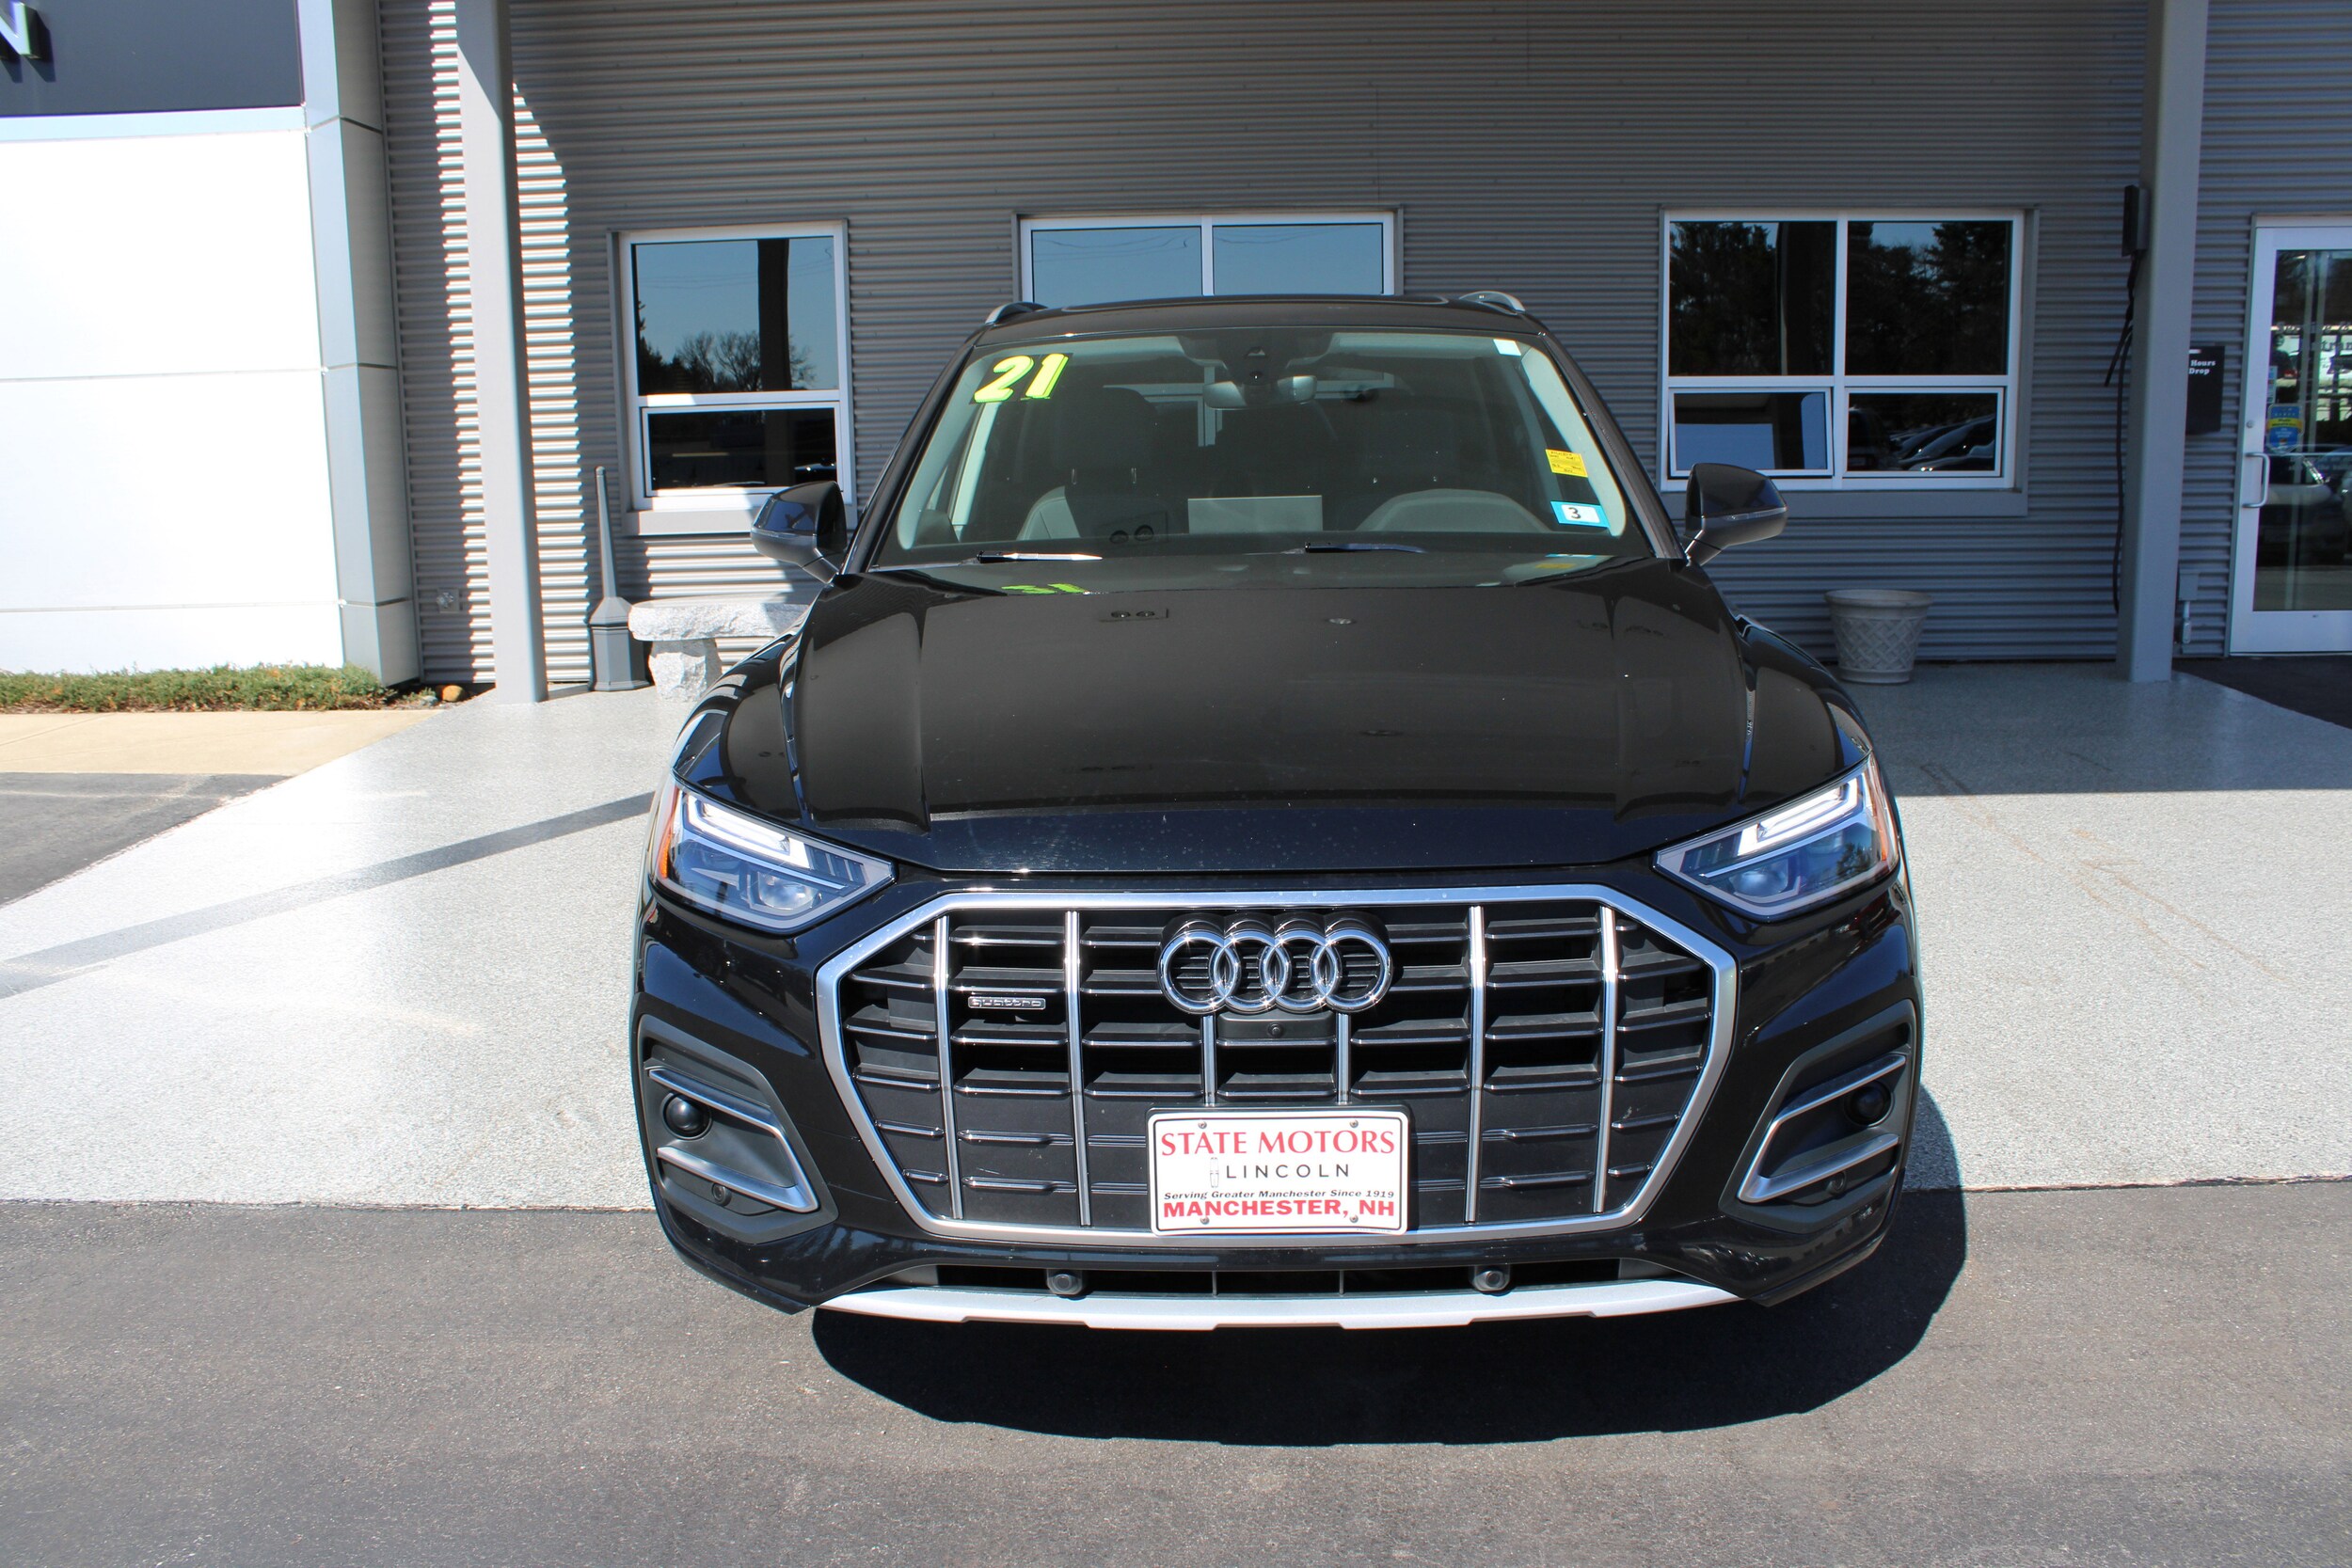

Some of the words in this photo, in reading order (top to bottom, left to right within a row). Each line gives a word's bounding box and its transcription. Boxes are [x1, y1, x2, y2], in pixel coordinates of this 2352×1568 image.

[974, 354, 1069, 404] 21
[1567, 506, 1581, 519] 3
[972, 998, 1042, 1007] quattro
[1161, 1132, 1247, 1156] STATE
[1258, 1131, 1395, 1154] MOTORS
[1226, 1164, 1349, 1179] LINCOLN
[1164, 1191, 1207, 1200] Serving
[1211, 1190, 1255, 1199] Greater
[1259, 1190, 1327, 1198] Manchester
[1330, 1189, 1361, 1197] Since
[1365, 1190, 1394, 1198] 1919
[1163, 1199, 1349, 1218] MANCHESTER,
[1359, 1199, 1394, 1216] NH
